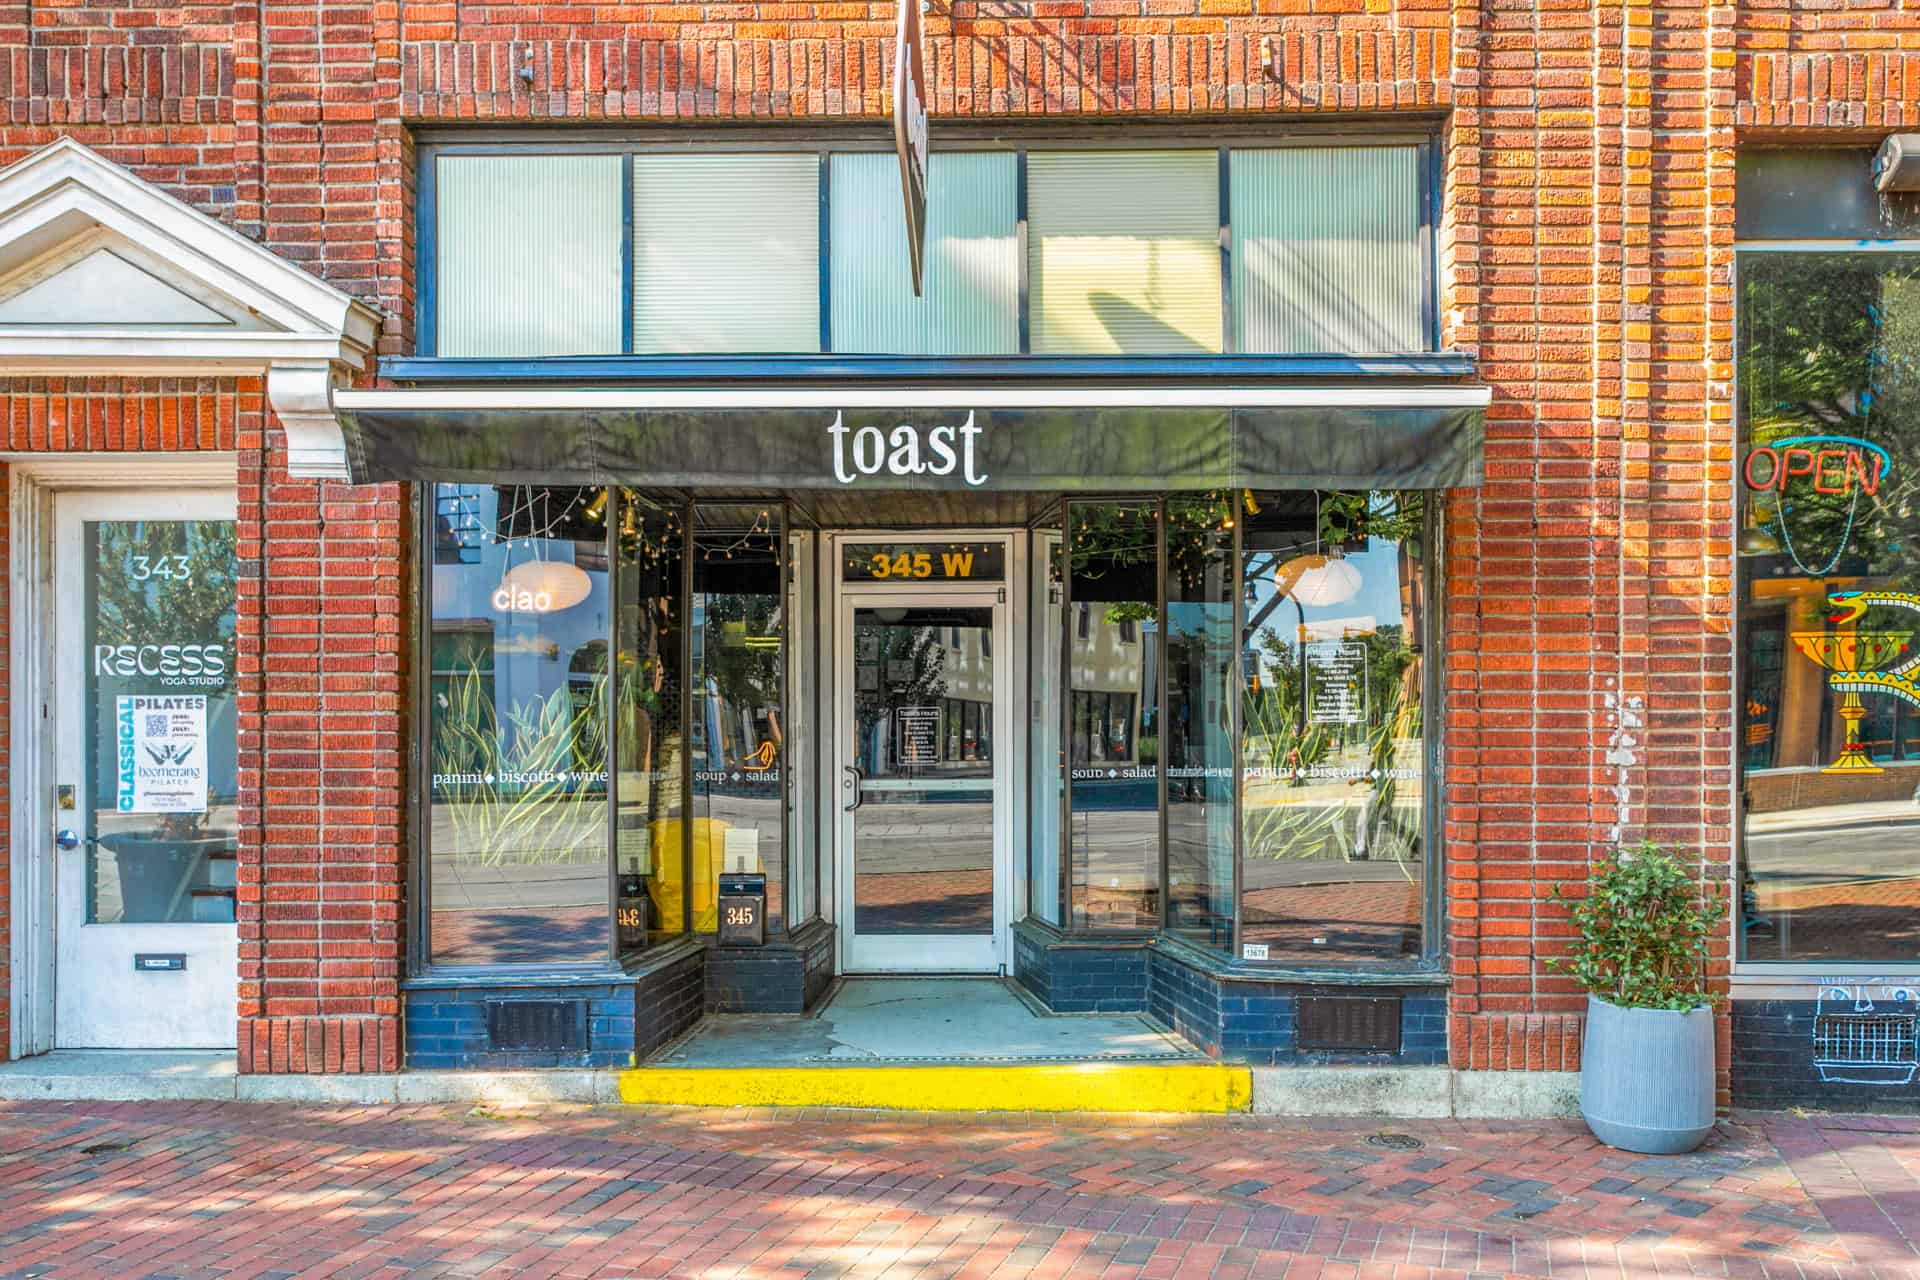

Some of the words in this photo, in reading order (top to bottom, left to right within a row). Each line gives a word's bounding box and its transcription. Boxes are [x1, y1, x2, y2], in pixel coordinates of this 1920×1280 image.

[827, 409, 988, 485] toast
[1745, 447, 1882, 496] OPEN
[132, 555, 191, 580] 343
[871, 553, 932, 578] 345
[941, 553, 974, 577] W
[95, 644, 224, 676] RECESS
[160, 677, 187, 686] YOGA
[189, 677, 225, 686] STUDIO
[135, 698, 205, 710] PILATES
[119, 697, 135, 811] CLASSICAL
[138, 766, 200, 779] boomerang
[433, 767, 482, 788] panini
[499, 768, 555, 783] biscotti
[567, 768, 608, 783] wine
[695, 770, 727, 785] soup
[745, 769, 779, 782] salad
[1122, 765, 1157, 778] salad
[1243, 766, 1293, 782] panini
[1310, 764, 1366, 779] biscotti
[727, 907, 753, 926] 345
